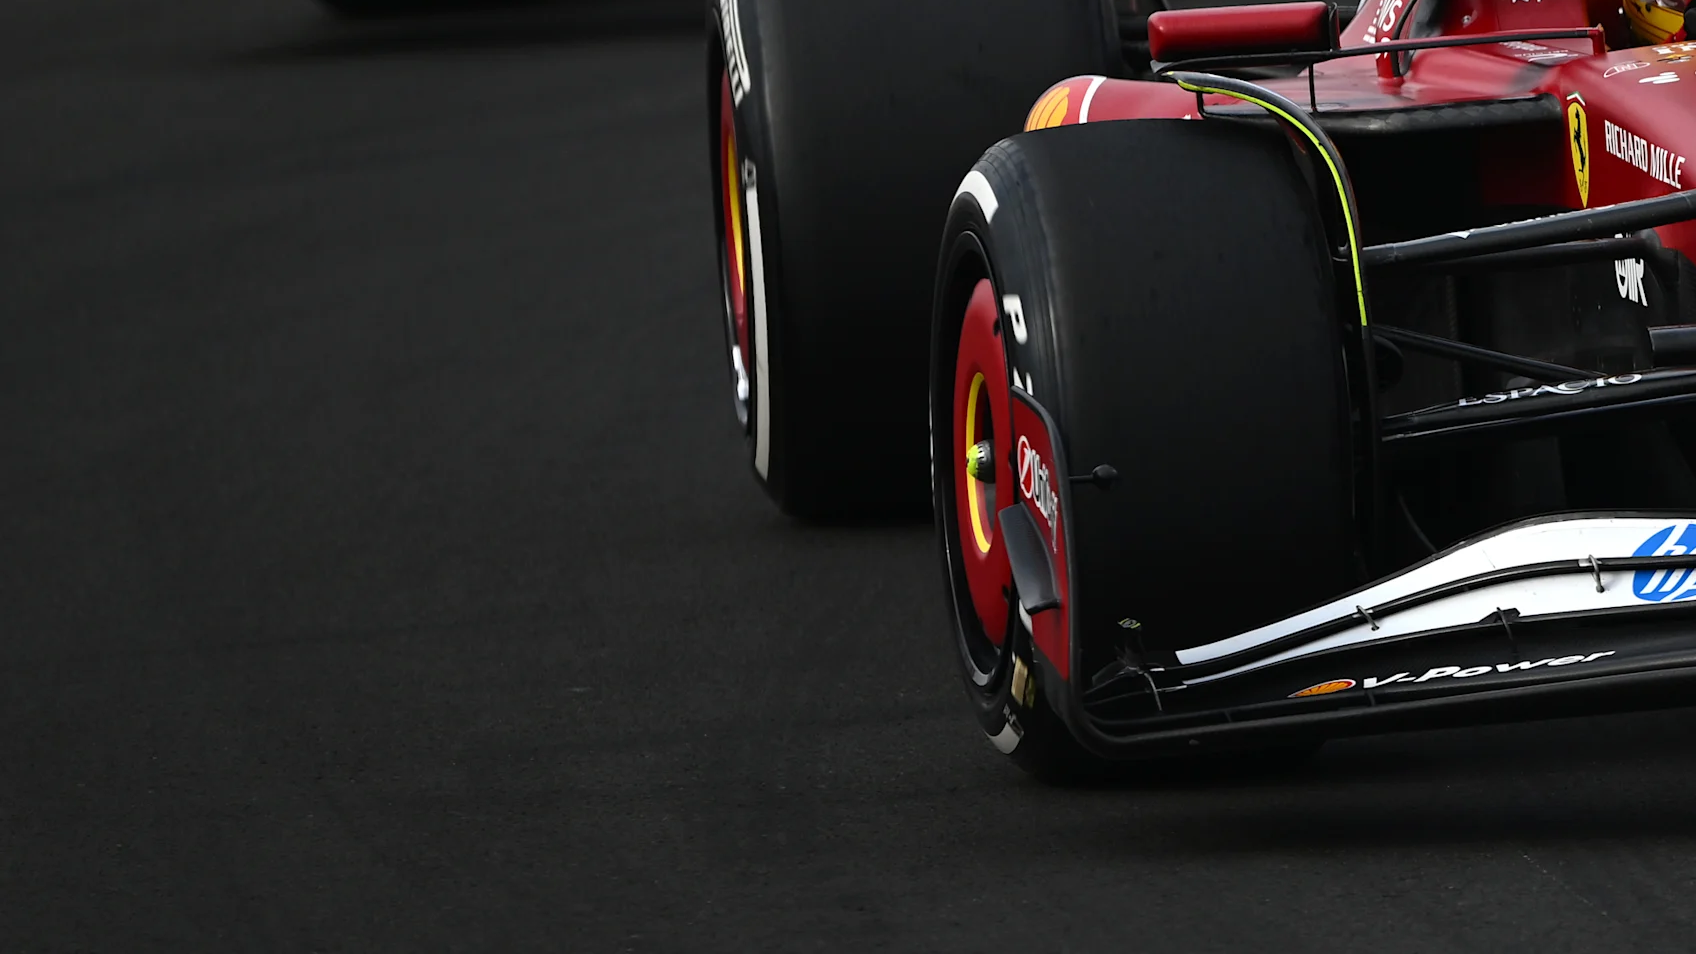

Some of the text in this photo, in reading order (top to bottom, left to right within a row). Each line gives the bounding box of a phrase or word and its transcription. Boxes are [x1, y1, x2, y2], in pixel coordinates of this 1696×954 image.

[1604, 119, 1686, 190] RICHARD MILLE
[1363, 650, 1616, 689] V-Power
